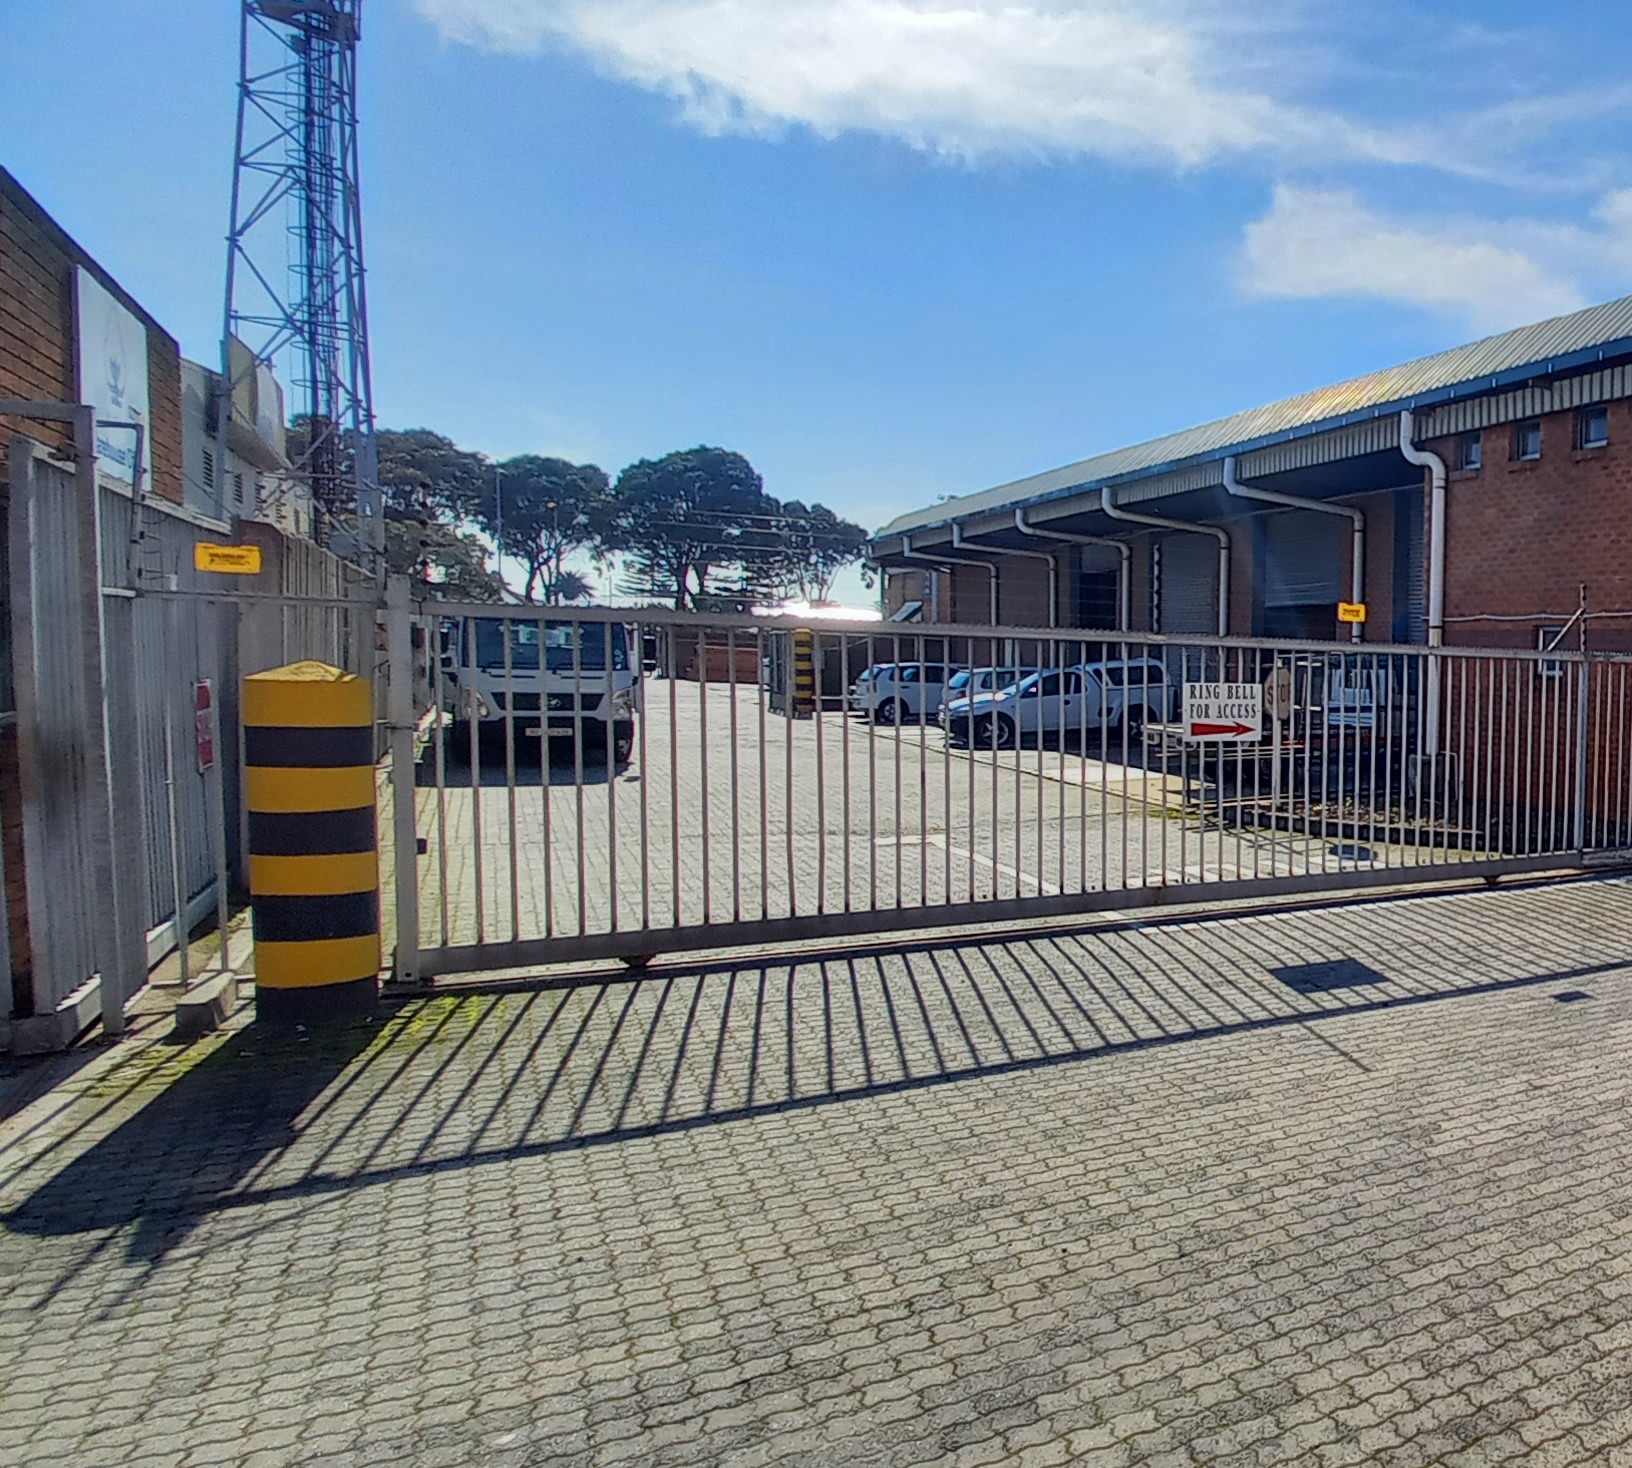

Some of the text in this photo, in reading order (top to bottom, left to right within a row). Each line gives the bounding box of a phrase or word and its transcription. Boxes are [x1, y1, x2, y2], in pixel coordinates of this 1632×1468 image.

[1189, 685, 1256, 699] RING BELL
[1189, 704, 1256, 719] FOR ACCESS
